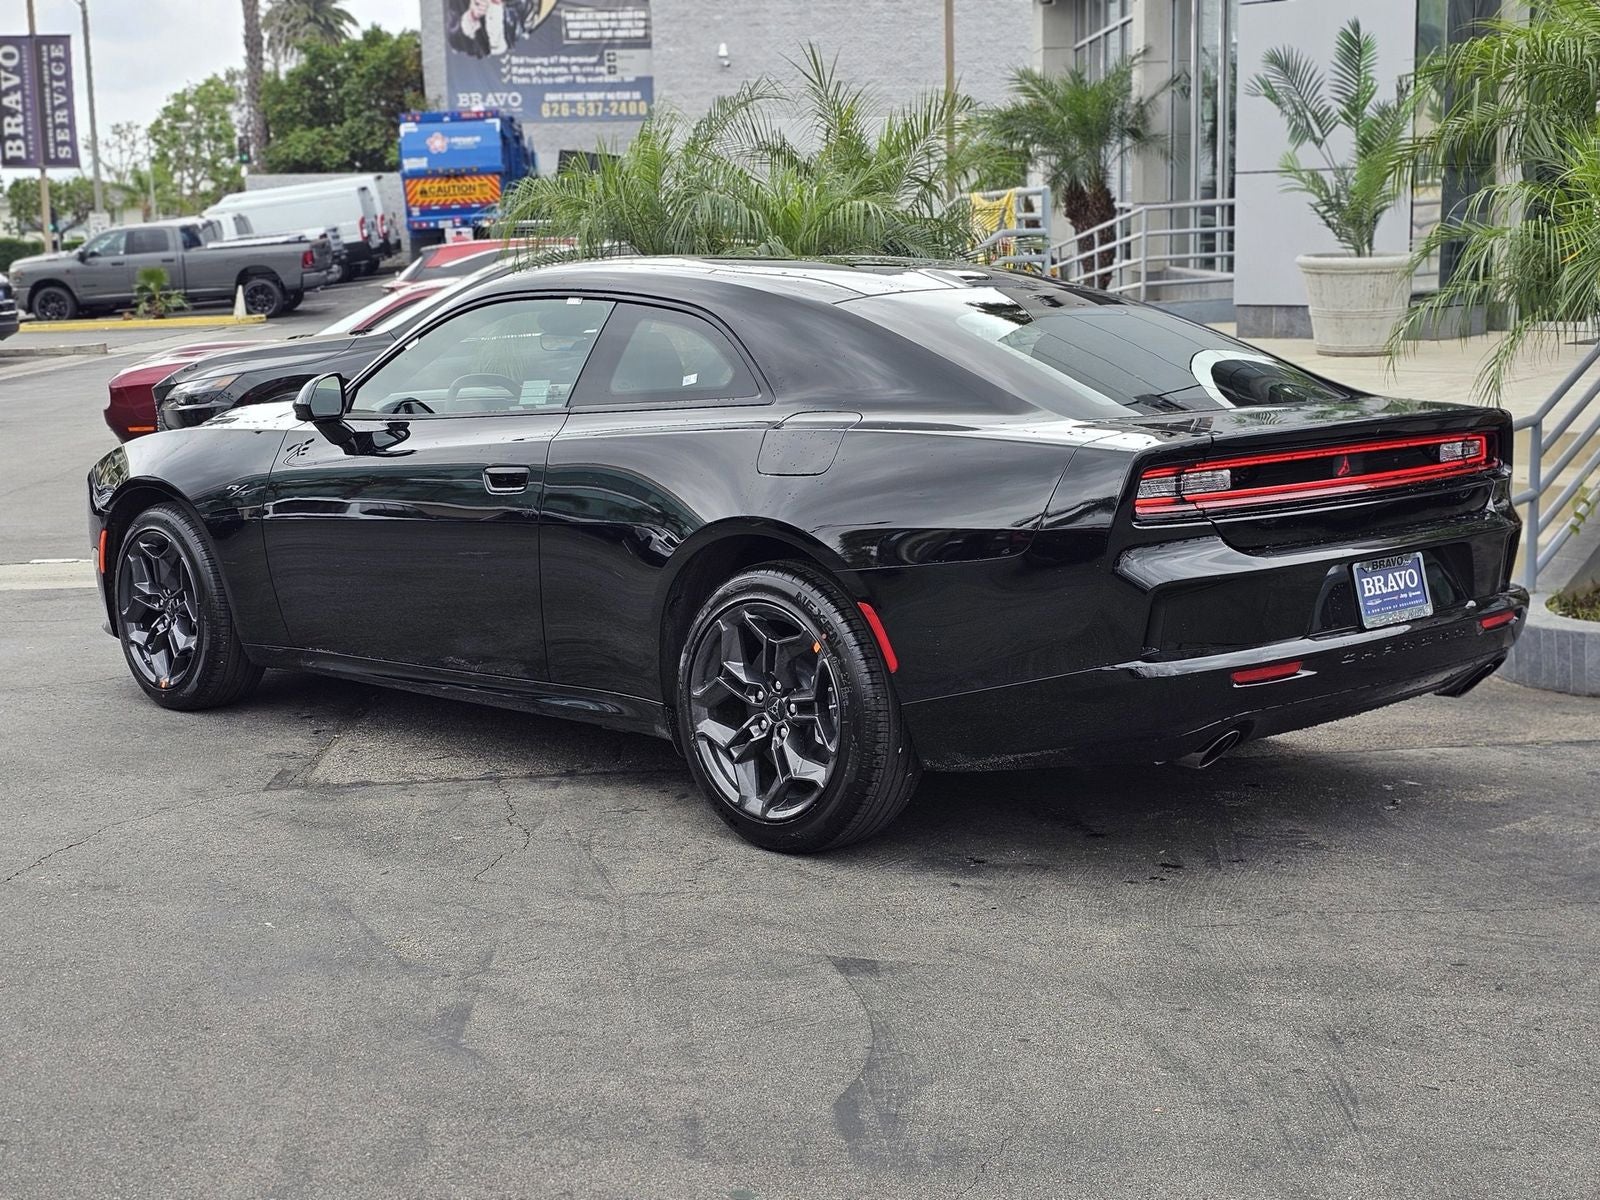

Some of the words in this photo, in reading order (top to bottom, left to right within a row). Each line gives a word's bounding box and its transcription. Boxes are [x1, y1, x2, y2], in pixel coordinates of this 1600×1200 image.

[0, 44, 27, 160] BRAVO
[49, 44, 72, 159] SERVICE
[457, 92, 522, 107] BRAVO
[428, 184, 476, 194] CAUTION
[1371, 556, 1404, 570] BRAVO
[1361, 568, 1418, 597] BRAVO
[795, 591, 843, 648] NEXEN
